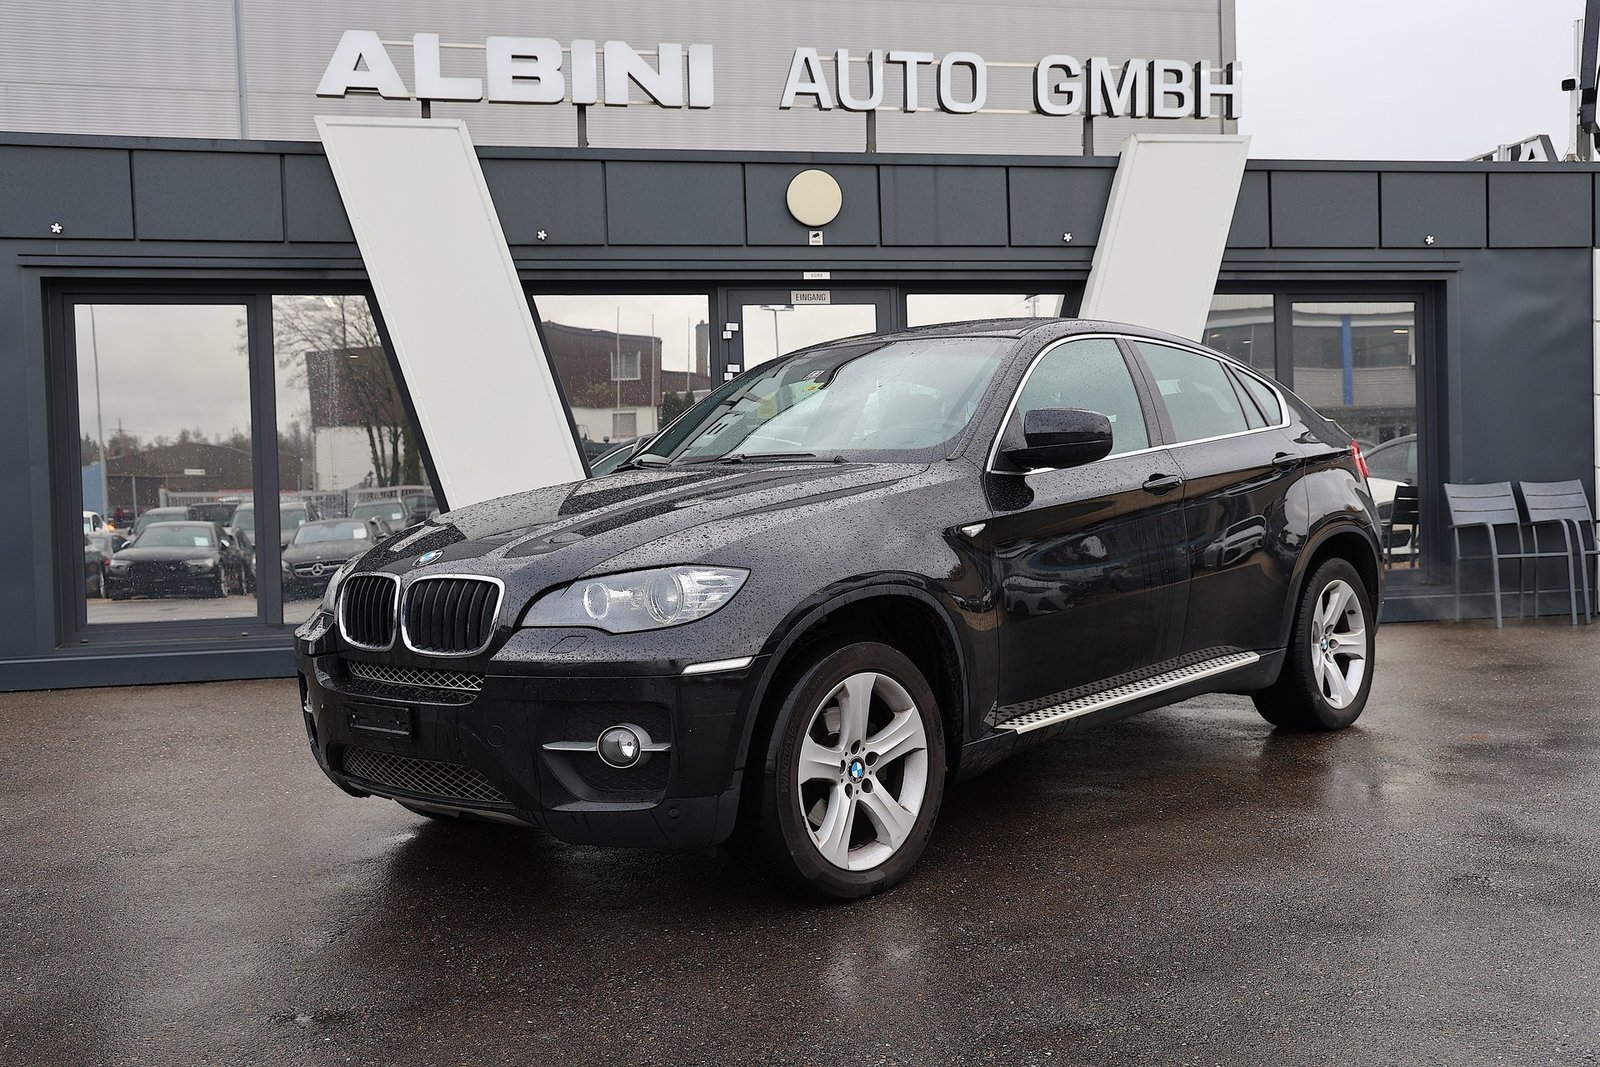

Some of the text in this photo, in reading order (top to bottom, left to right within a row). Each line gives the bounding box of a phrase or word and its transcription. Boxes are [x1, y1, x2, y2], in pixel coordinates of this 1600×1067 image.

[315, 30, 1243, 119] ALBINI AUTO GMBH
[795, 293, 826, 301] EINGANG
[781, 724, 797, 793] WINGUARD
